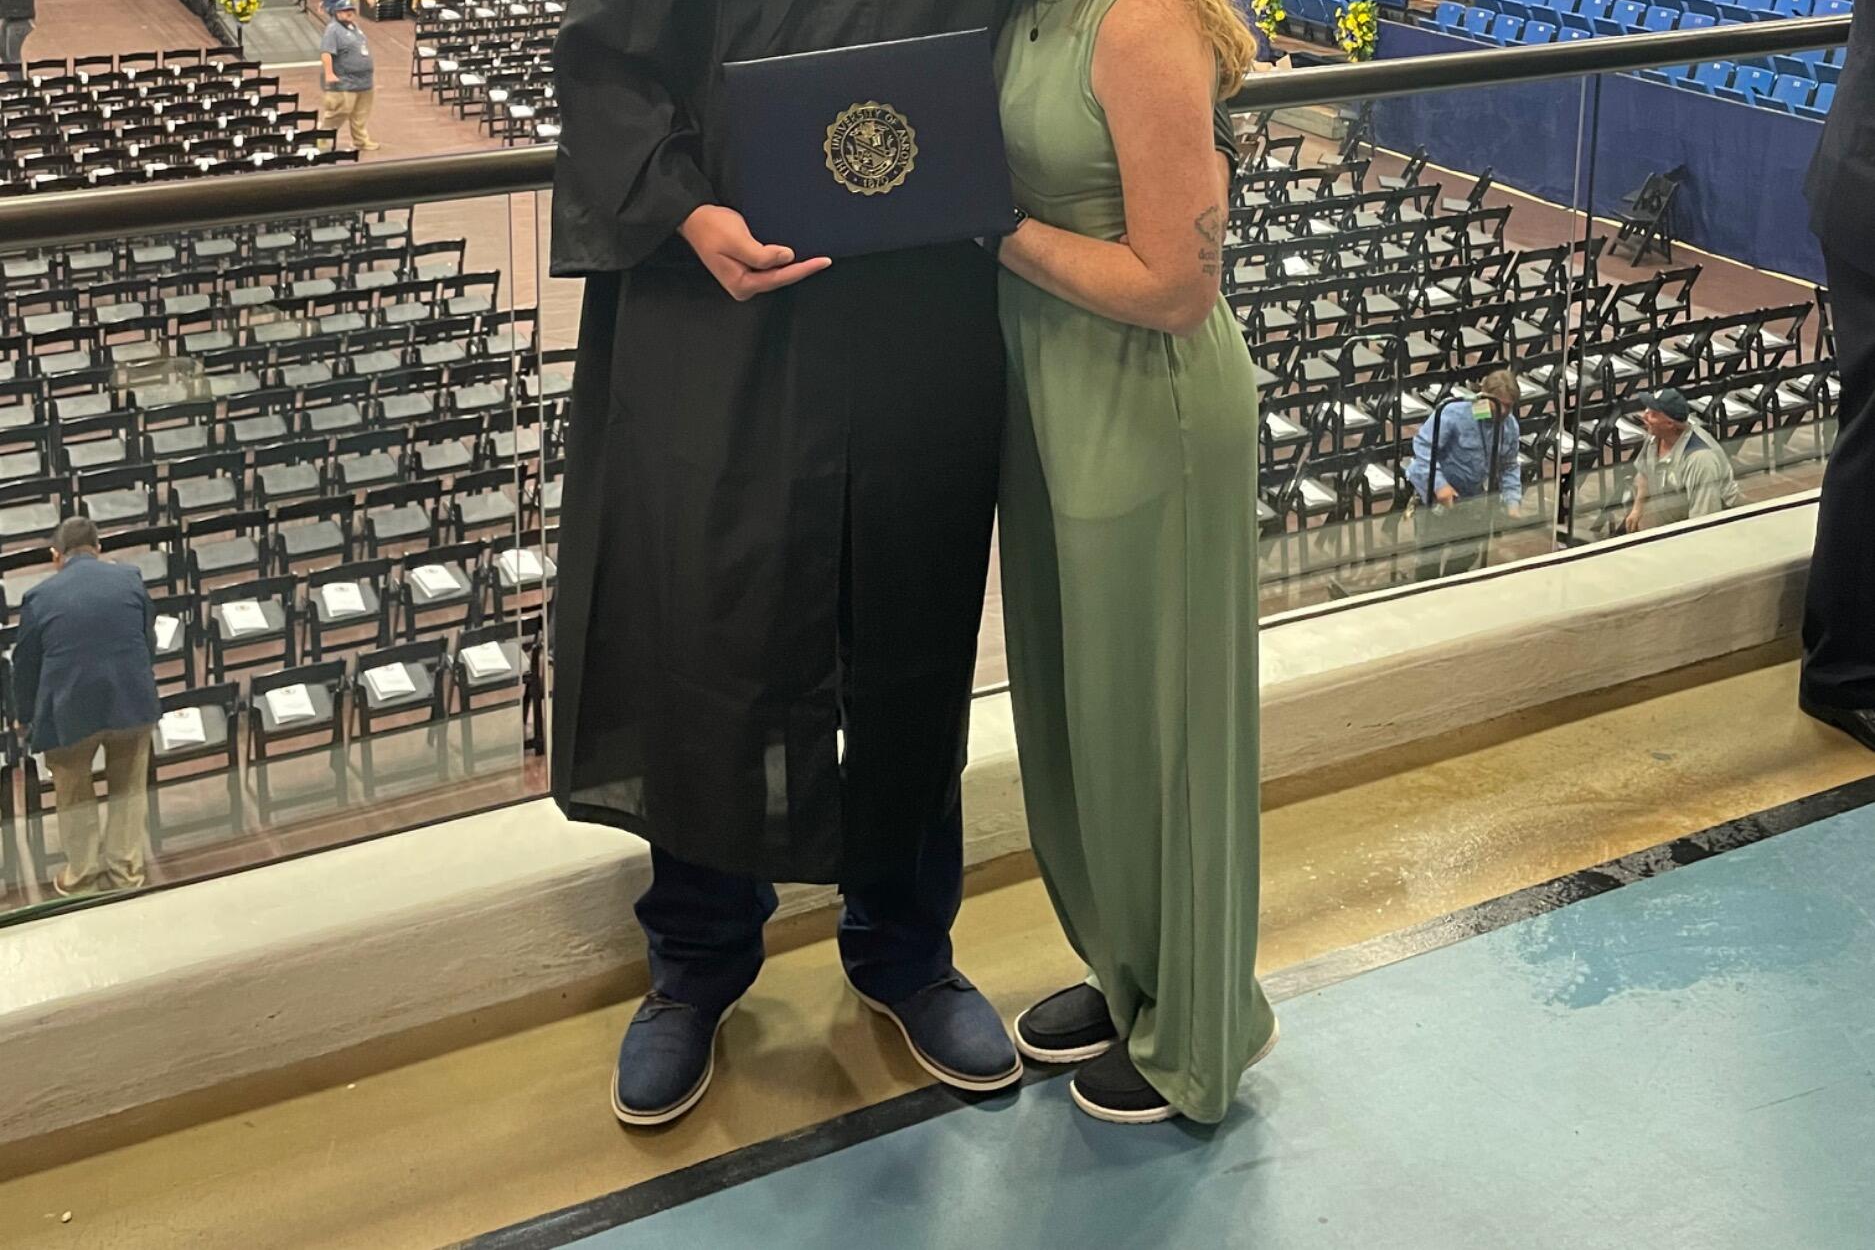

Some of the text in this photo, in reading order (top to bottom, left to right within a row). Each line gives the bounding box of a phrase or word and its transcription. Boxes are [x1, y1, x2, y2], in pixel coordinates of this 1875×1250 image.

[831, 109, 911, 177] THE UNIVERSITY OF AKRON
[863, 176, 889, 189] 1870
